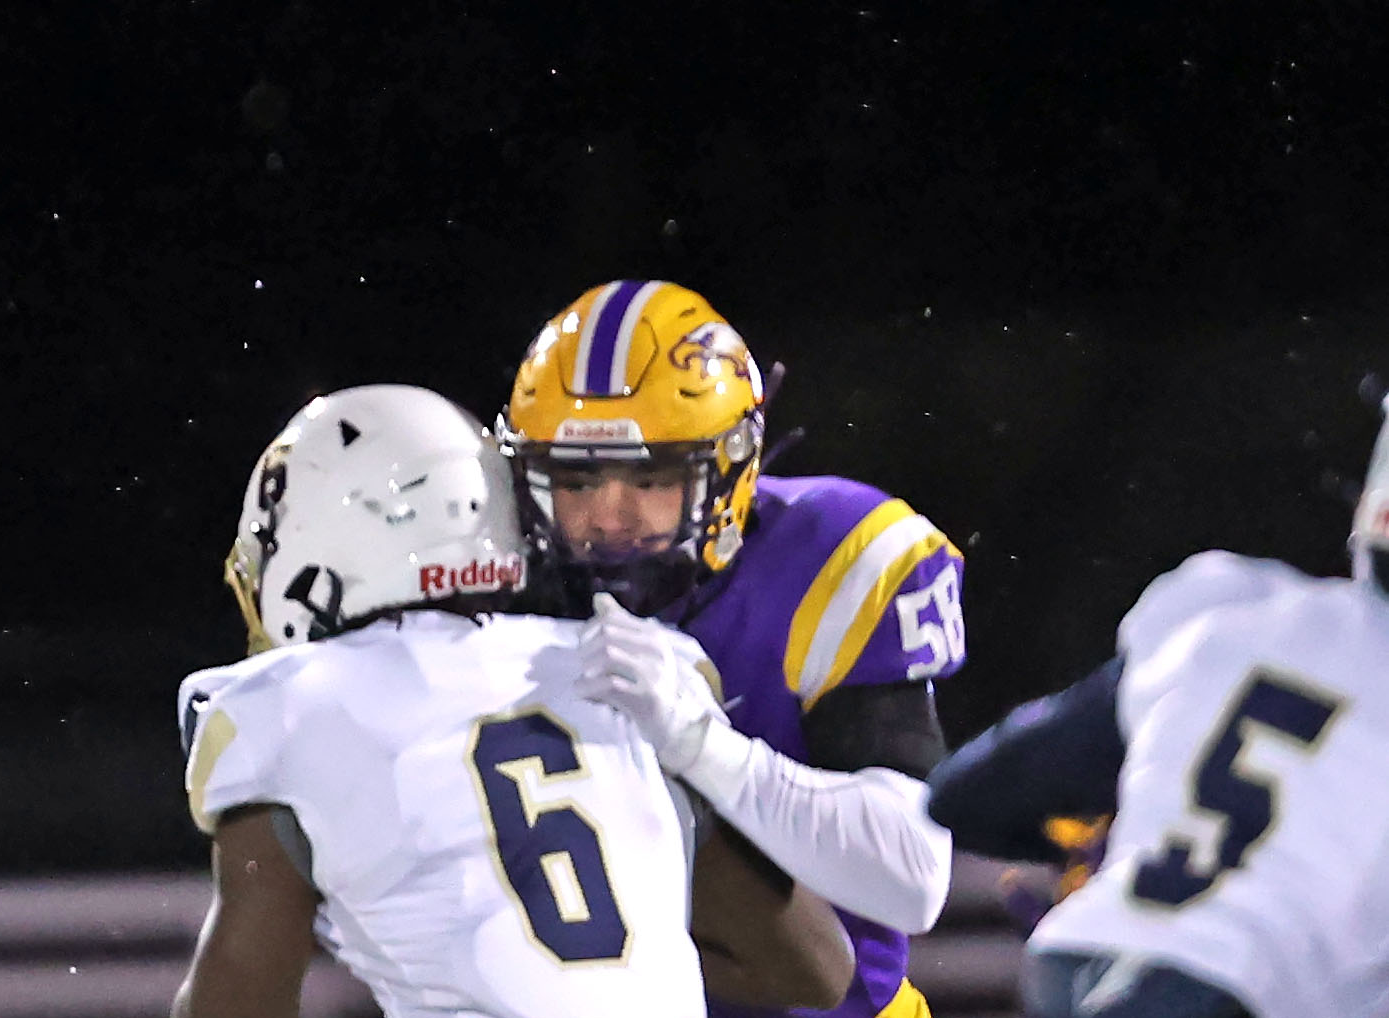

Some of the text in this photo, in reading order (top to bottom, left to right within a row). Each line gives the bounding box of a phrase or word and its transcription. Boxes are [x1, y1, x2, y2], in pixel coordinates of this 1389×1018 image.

[895, 561, 966, 681] 58
[464, 703, 635, 970] 6
[1127, 665, 1345, 915] 5
